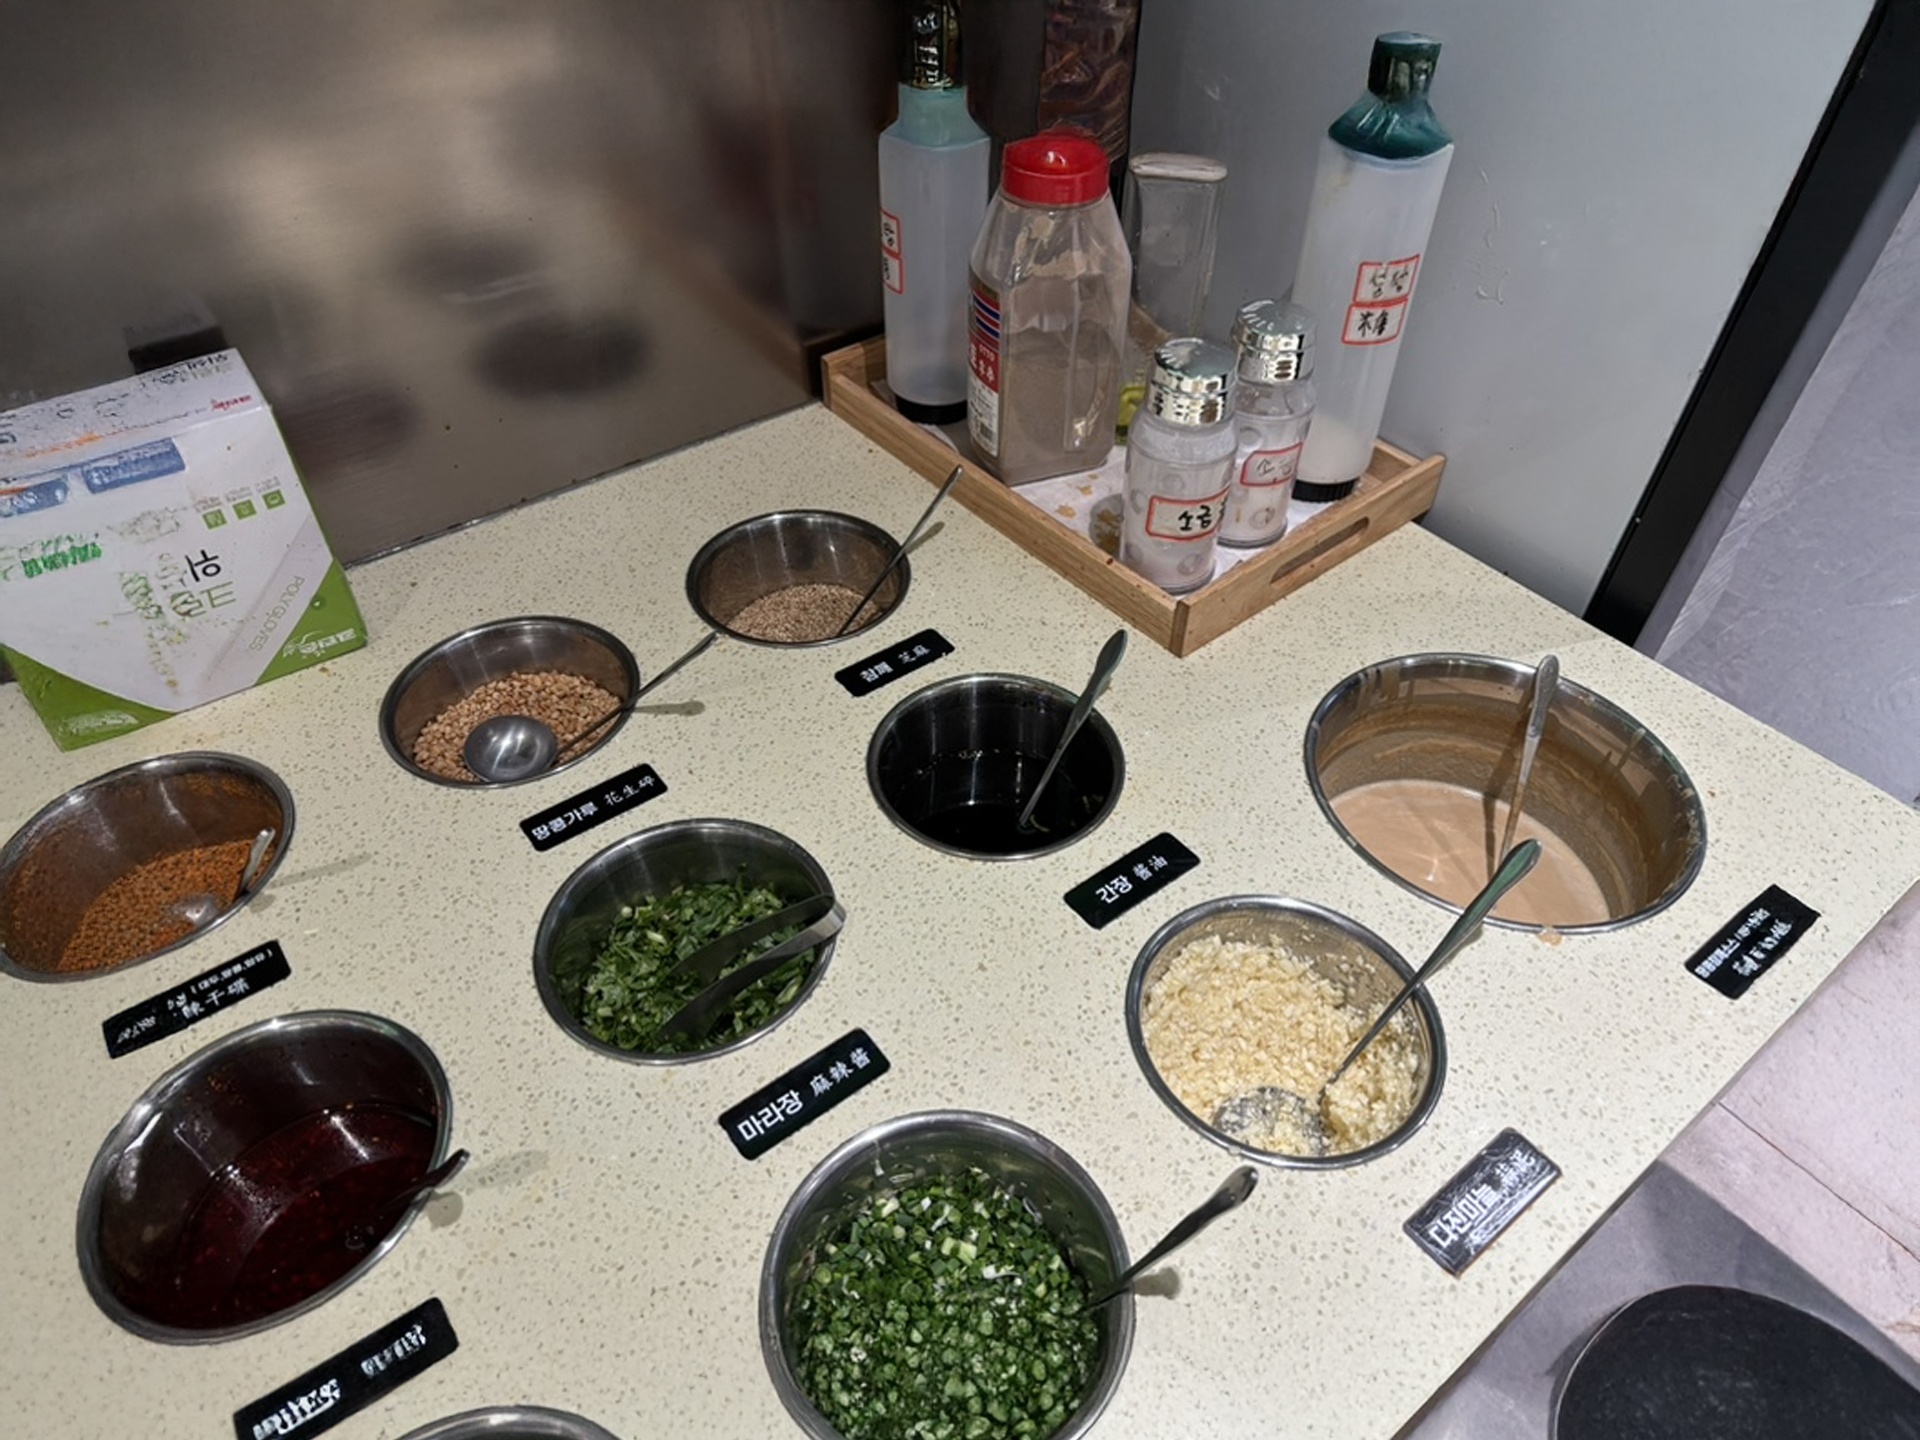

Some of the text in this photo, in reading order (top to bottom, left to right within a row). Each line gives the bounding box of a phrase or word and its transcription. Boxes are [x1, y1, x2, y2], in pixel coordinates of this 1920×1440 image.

[1095, 875, 1133, 904] 간장
[737, 1089, 803, 1141] 마라장
[1428, 1183, 1503, 1249] 다진마늘
